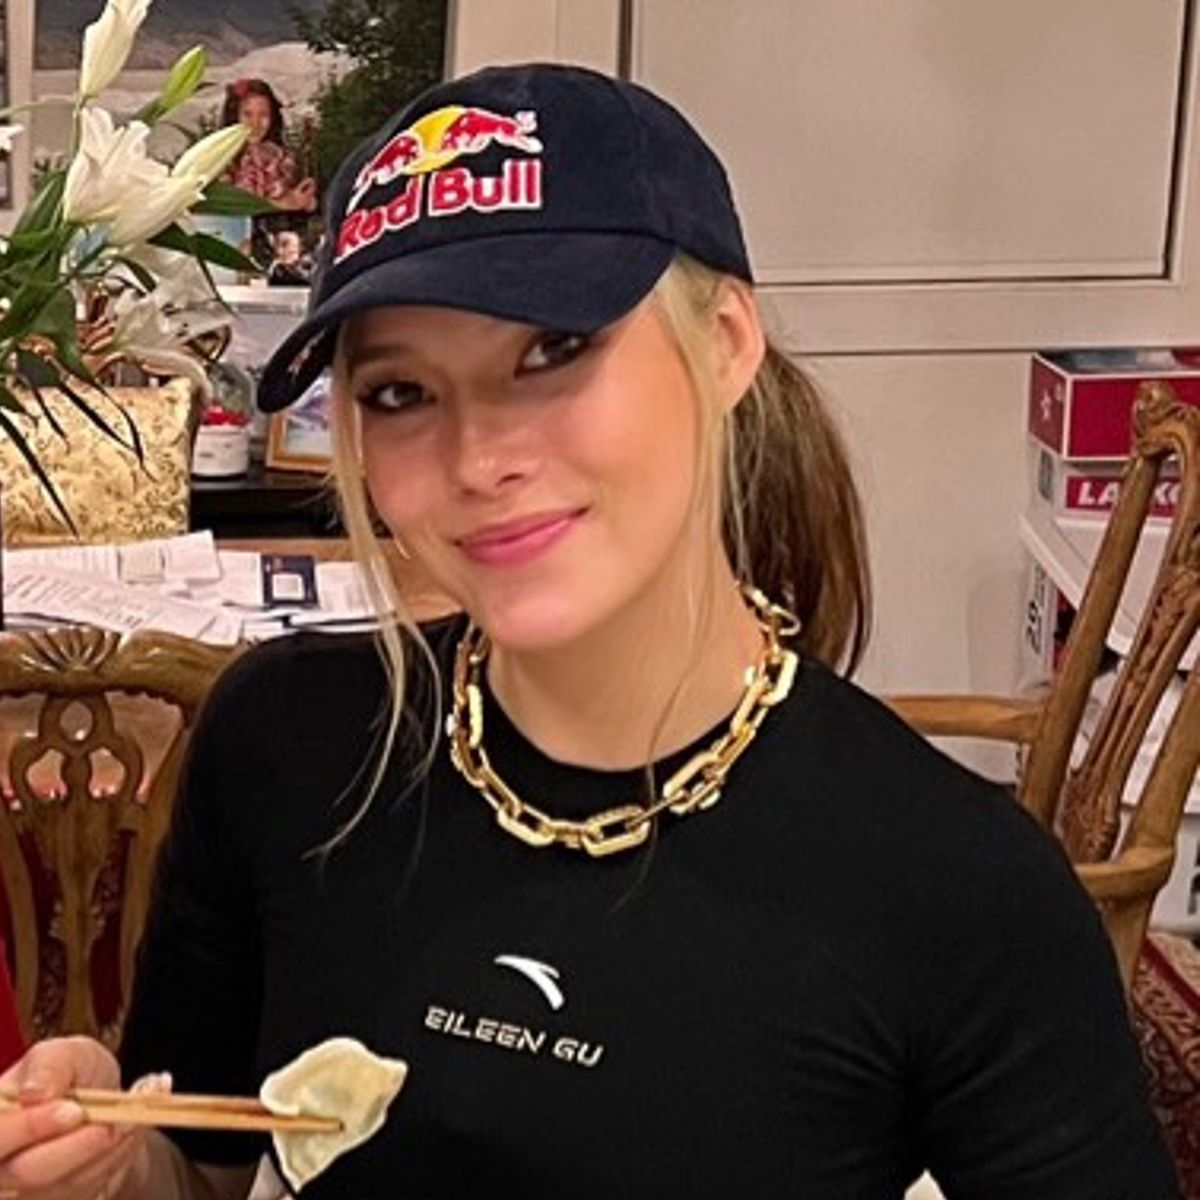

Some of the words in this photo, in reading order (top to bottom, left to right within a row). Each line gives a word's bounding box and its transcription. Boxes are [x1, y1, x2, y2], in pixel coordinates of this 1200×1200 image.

[335, 173, 421, 260] Red
[430, 160, 541, 215] Bull
[425, 1006, 546, 1054] EILEEN
[552, 1037, 604, 1067] GU
